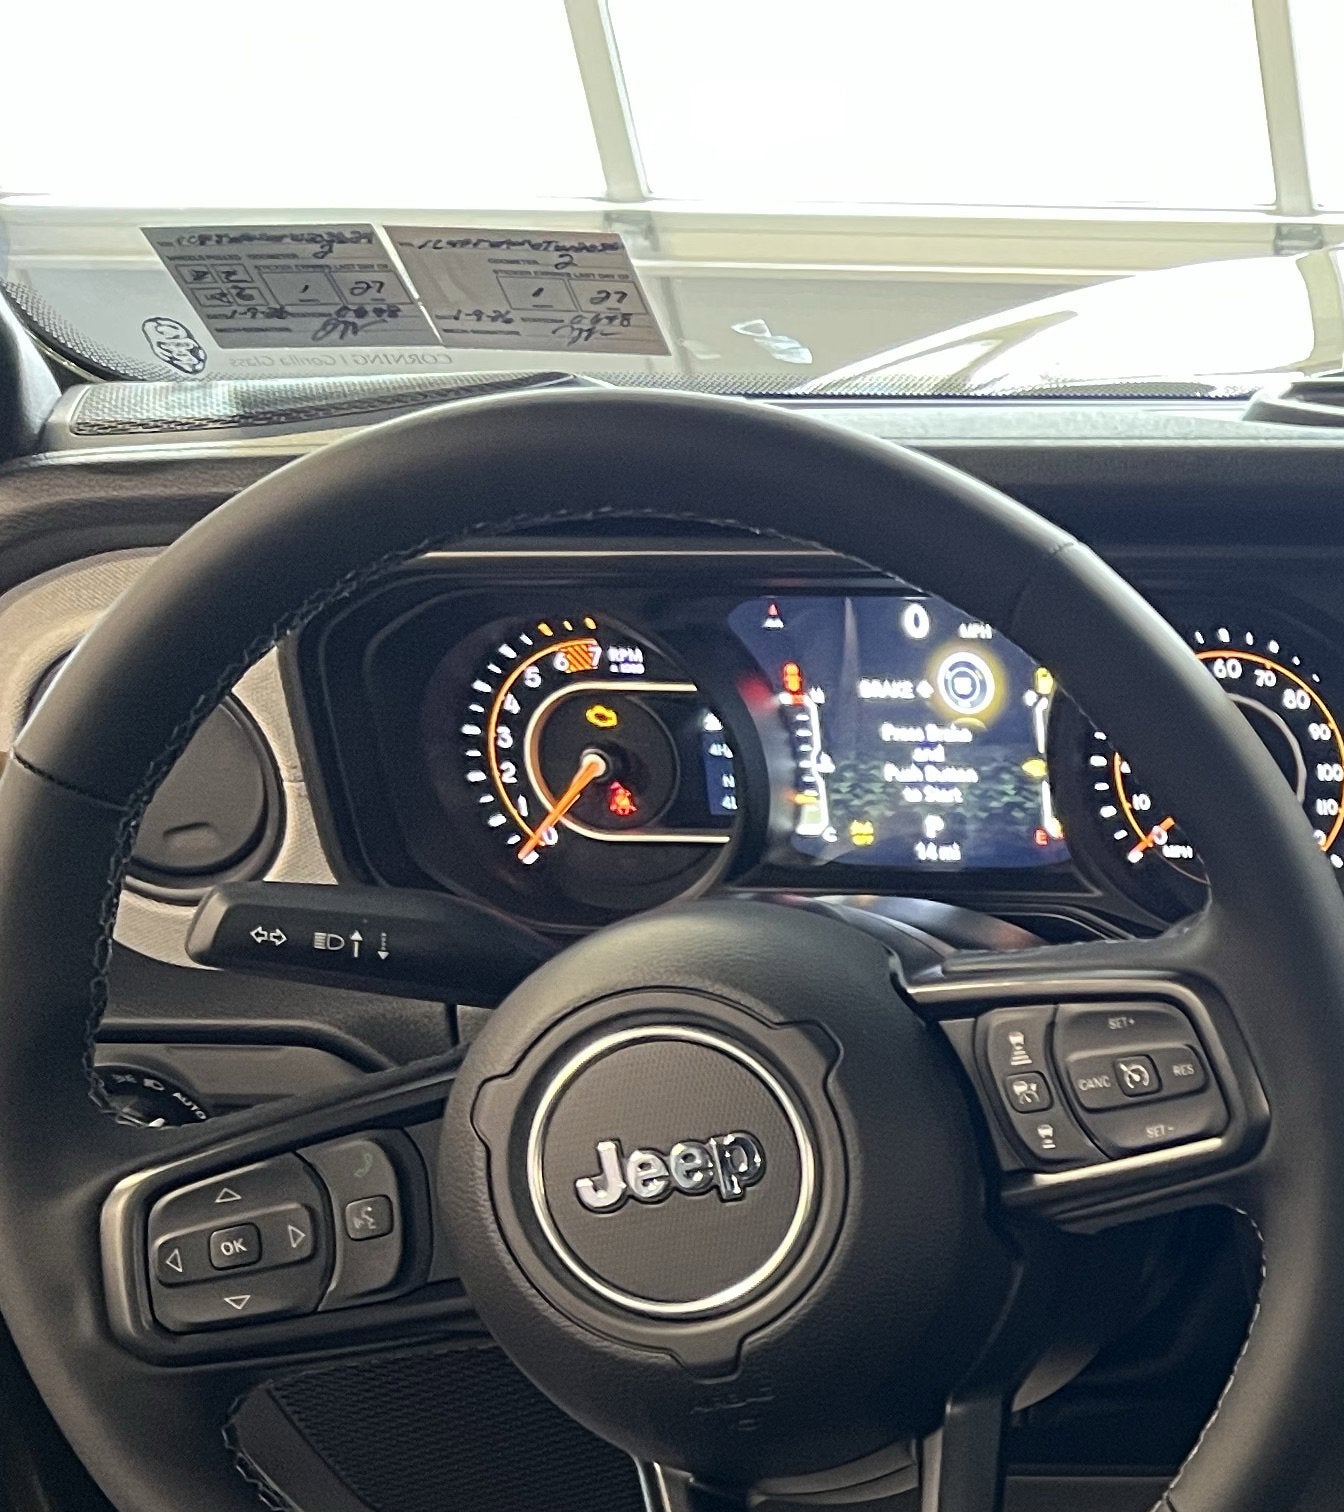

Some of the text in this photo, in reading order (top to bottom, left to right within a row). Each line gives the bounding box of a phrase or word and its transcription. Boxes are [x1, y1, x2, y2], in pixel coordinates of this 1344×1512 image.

[904, 603, 930, 639] 0
[553, 651, 571, 672] 6
[586, 644, 602, 667] 7
[607, 645, 644, 663] RPM
[523, 665, 542, 688] 5
[1213, 658, 1242, 679] 60
[1254, 668, 1276, 687] 70
[503, 693, 521, 714] 4
[1282, 688, 1311, 710] 80
[496, 725, 514, 749] 3
[1308, 722, 1332, 741] 90
[500, 761, 517, 784] 2
[1316, 763, 1344, 782] 100
[1131, 793, 1152, 811] 10
[1316, 798, 1340, 816] 110
[1034, 828, 1049, 846] E
[1172, 1063, 1195, 1077] RES
[1078, 1075, 1111, 1092] CANC
[574, 1130, 767, 1214] Jeep
[220, 1240, 248, 1256] OK
